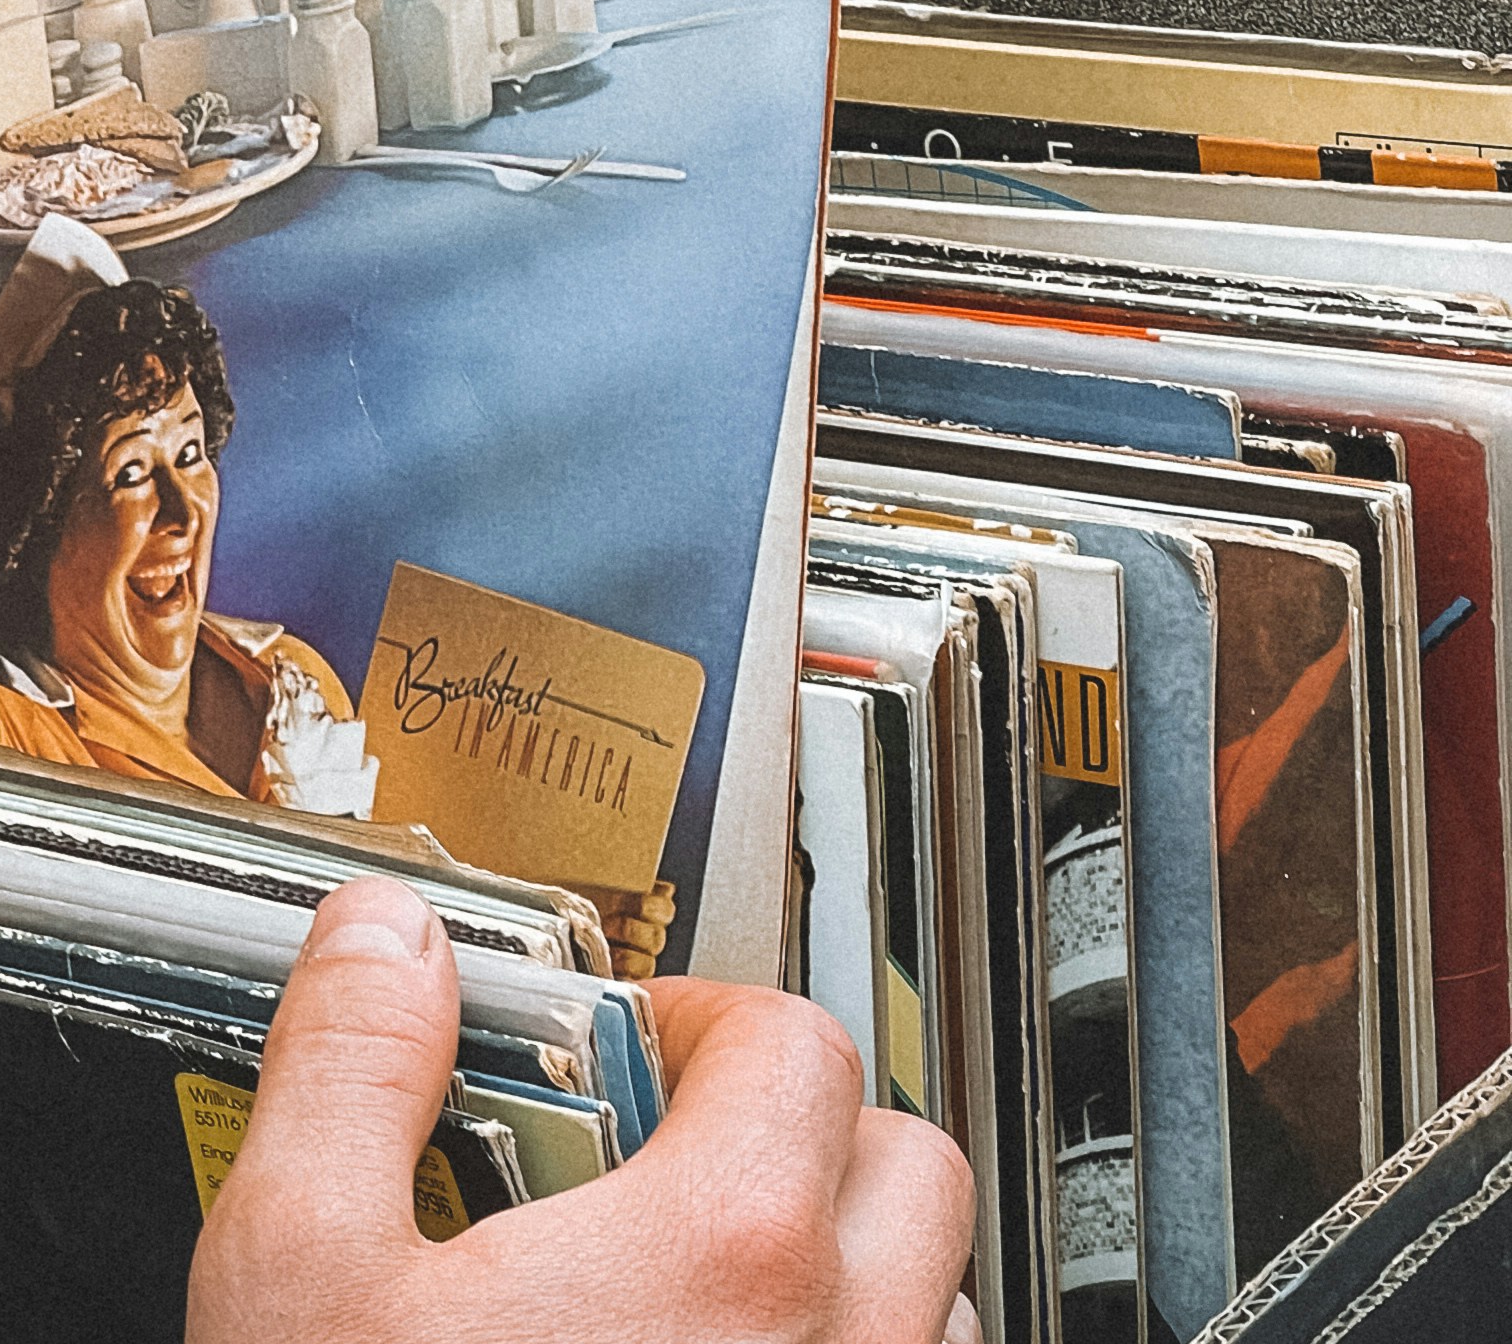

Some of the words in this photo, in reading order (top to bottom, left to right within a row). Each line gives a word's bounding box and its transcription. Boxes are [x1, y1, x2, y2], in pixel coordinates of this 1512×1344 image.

[394, 637, 552, 735] Breakfast
[453, 697, 491, 759] IN
[496, 712, 633, 818] AMERICA
[194, 1110, 241, 1131] 55116
